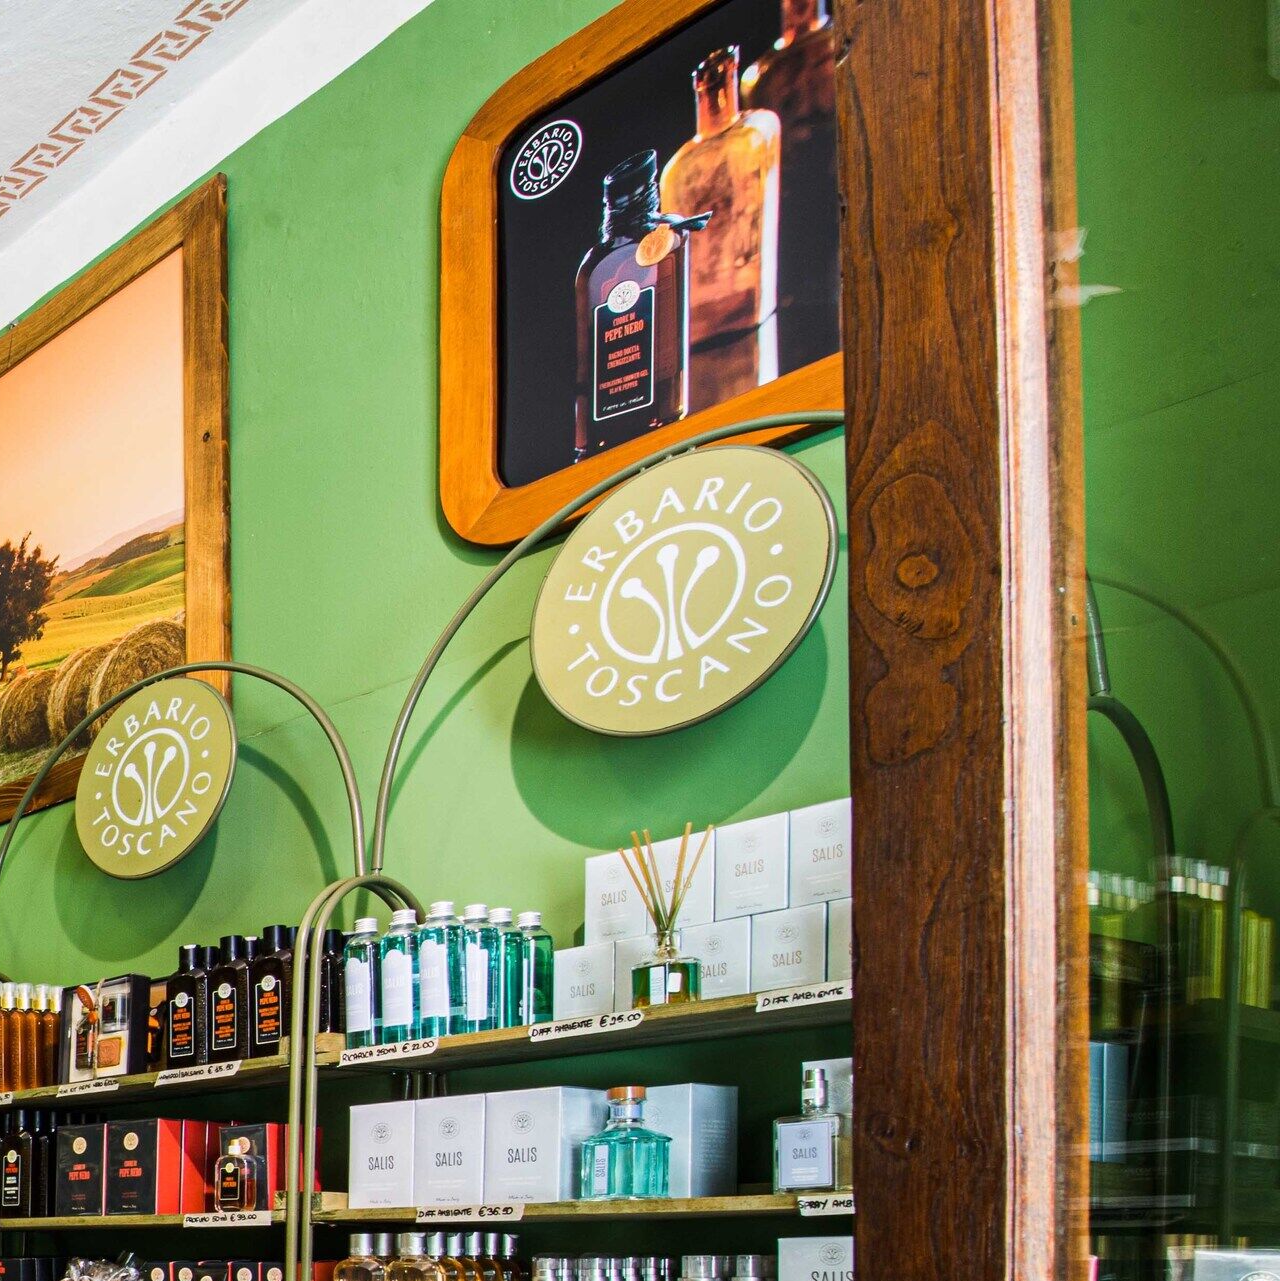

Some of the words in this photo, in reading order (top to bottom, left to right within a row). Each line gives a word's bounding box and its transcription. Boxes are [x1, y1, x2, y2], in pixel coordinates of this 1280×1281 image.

[519, 129, 572, 169] ERBARIO
[519, 150, 574, 193] TOSCANO
[605, 325, 622, 342] PEPE
[624, 319, 644, 337] NERO
[567, 476, 783, 606] ERBARIO
[567, 573, 794, 705] TOSCANO
[95, 697, 209, 781] ERBARIO
[95, 772, 213, 855] TOSCANO
[735, 860, 765, 877] SALIS
[601, 889, 627, 906] SALIS
[772, 949, 803, 967] SALIS
[570, 982, 595, 999] SALIS
[785, 986, 844, 1004] AMBIENTE
[435, 1151, 463, 1167] SALIS
[507, 1146, 537, 1163] SALIS
[792, 1146, 818, 1160] SALIS
[368, 1155, 394, 1170] SALIS
[595, 1157, 606, 1177] SALIS
[798, 1199, 827, 1210] SPRAY
